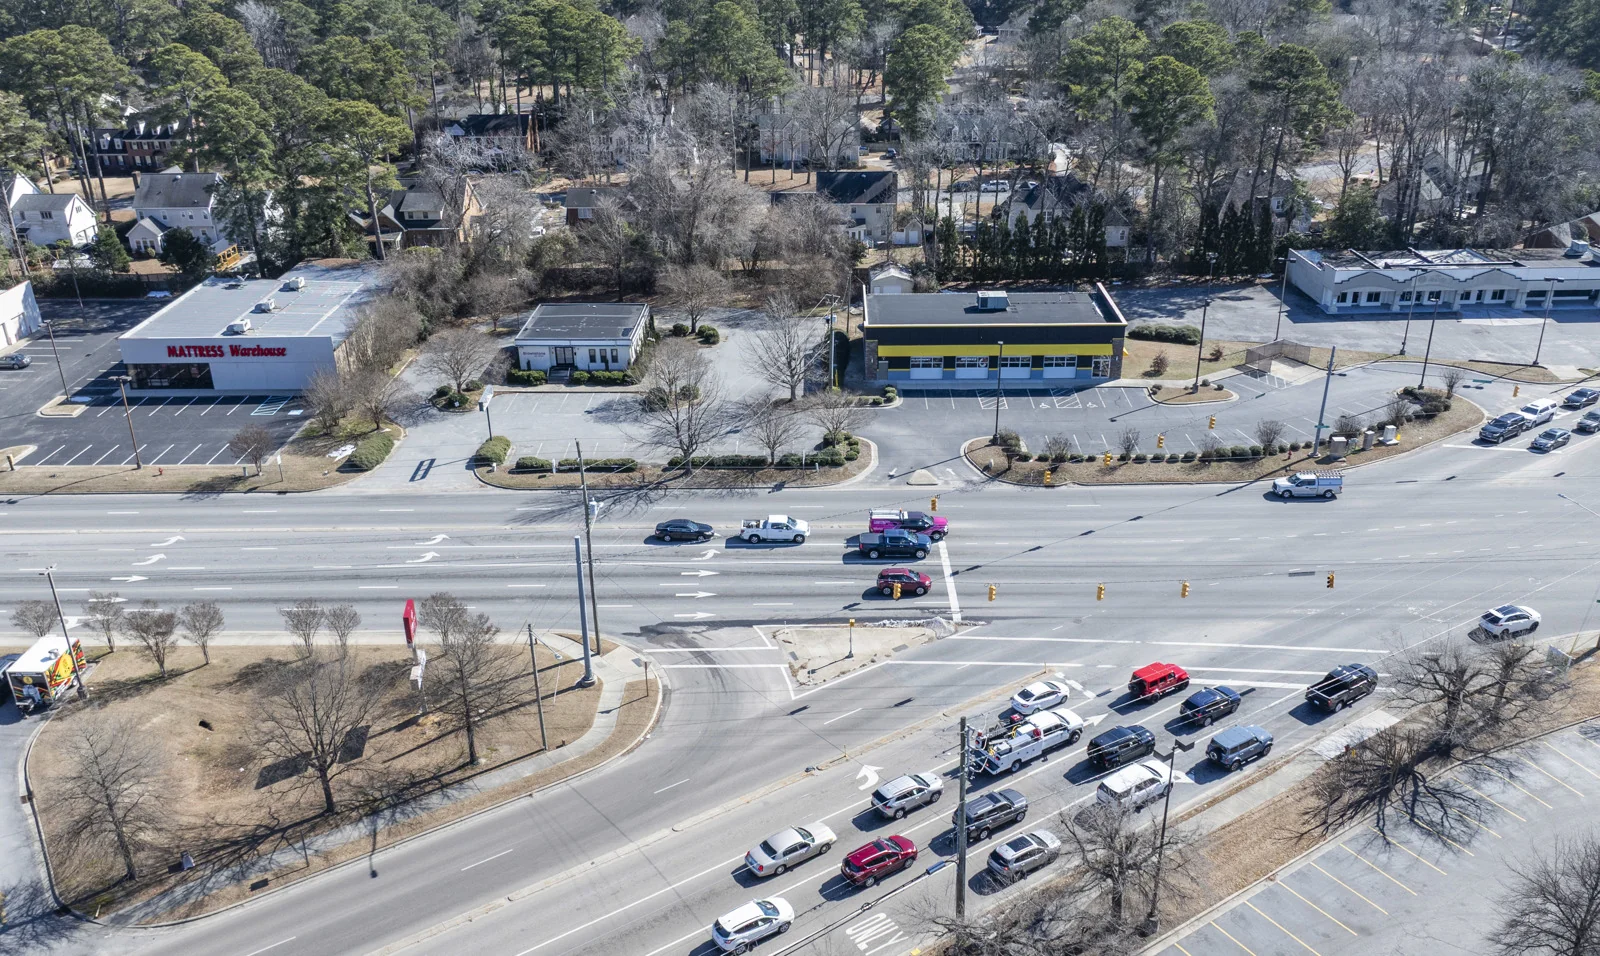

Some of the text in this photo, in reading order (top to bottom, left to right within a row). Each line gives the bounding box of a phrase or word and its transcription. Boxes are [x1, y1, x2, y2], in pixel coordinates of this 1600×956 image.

[167, 344, 286, 358] MATTRESS Warehouse
[845, 912, 909, 956] ONLY
